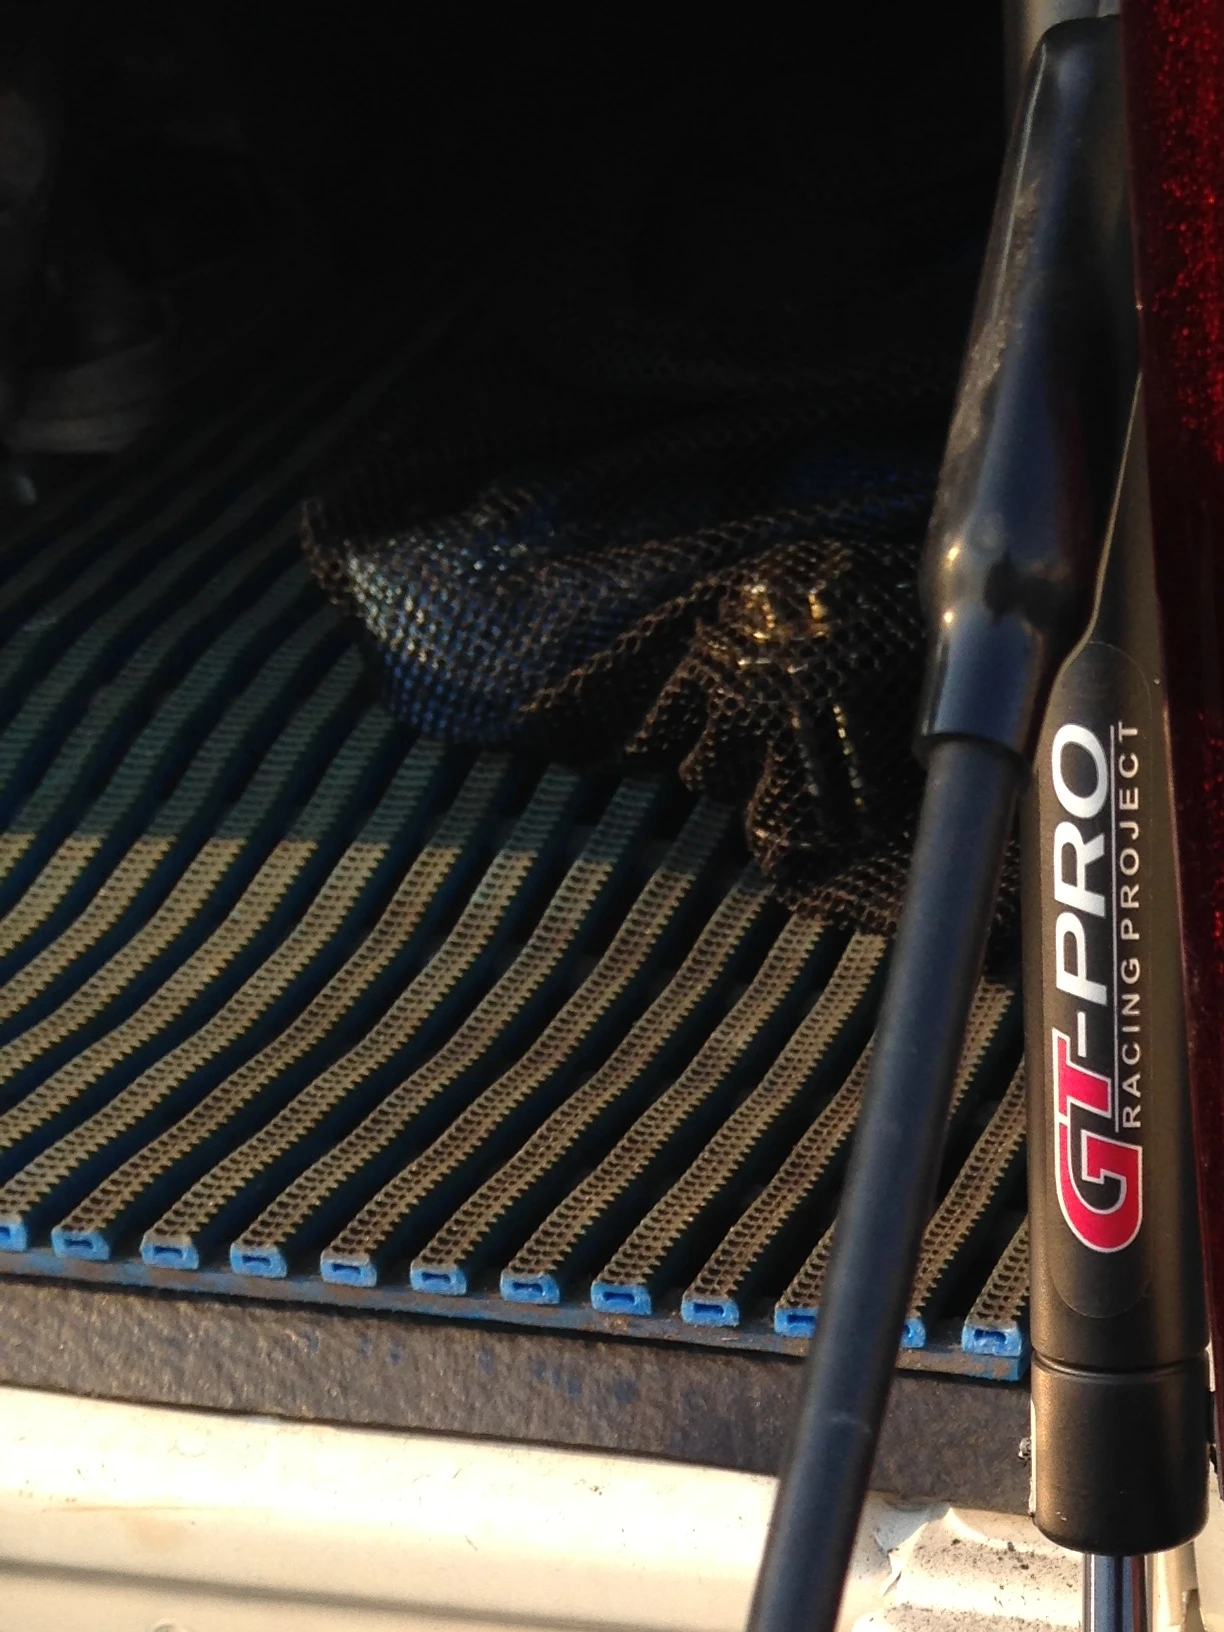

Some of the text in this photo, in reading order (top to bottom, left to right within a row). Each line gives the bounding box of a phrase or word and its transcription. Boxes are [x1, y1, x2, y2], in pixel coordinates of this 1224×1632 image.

[1052, 722, 1143, 1253] GT-PRO
[1117, 720, 1143, 1130] RACING PROJECT
